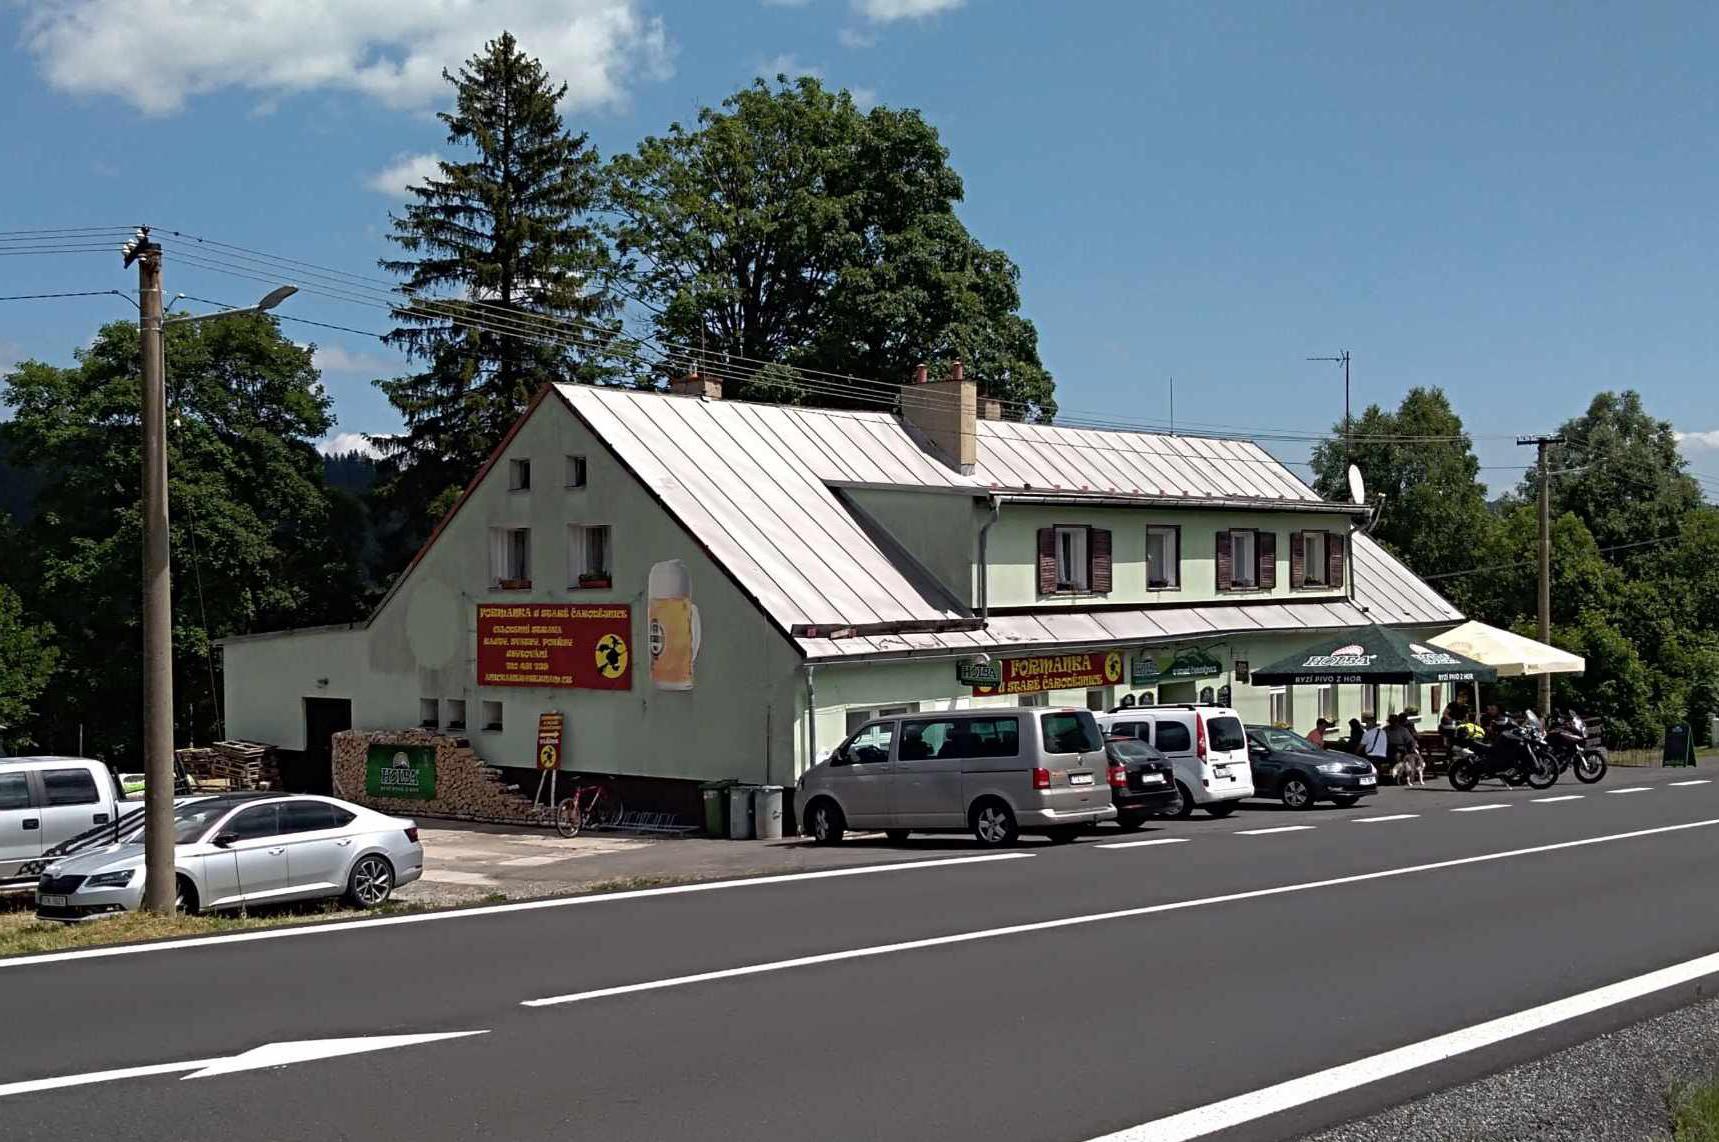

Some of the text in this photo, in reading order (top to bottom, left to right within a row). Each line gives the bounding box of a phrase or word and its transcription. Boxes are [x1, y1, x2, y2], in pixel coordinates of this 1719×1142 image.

[1010, 655, 1092, 678] FORMANKA
[1295, 674, 1313, 683] RYZÍ
[1315, 675, 1334, 683] PIVO
